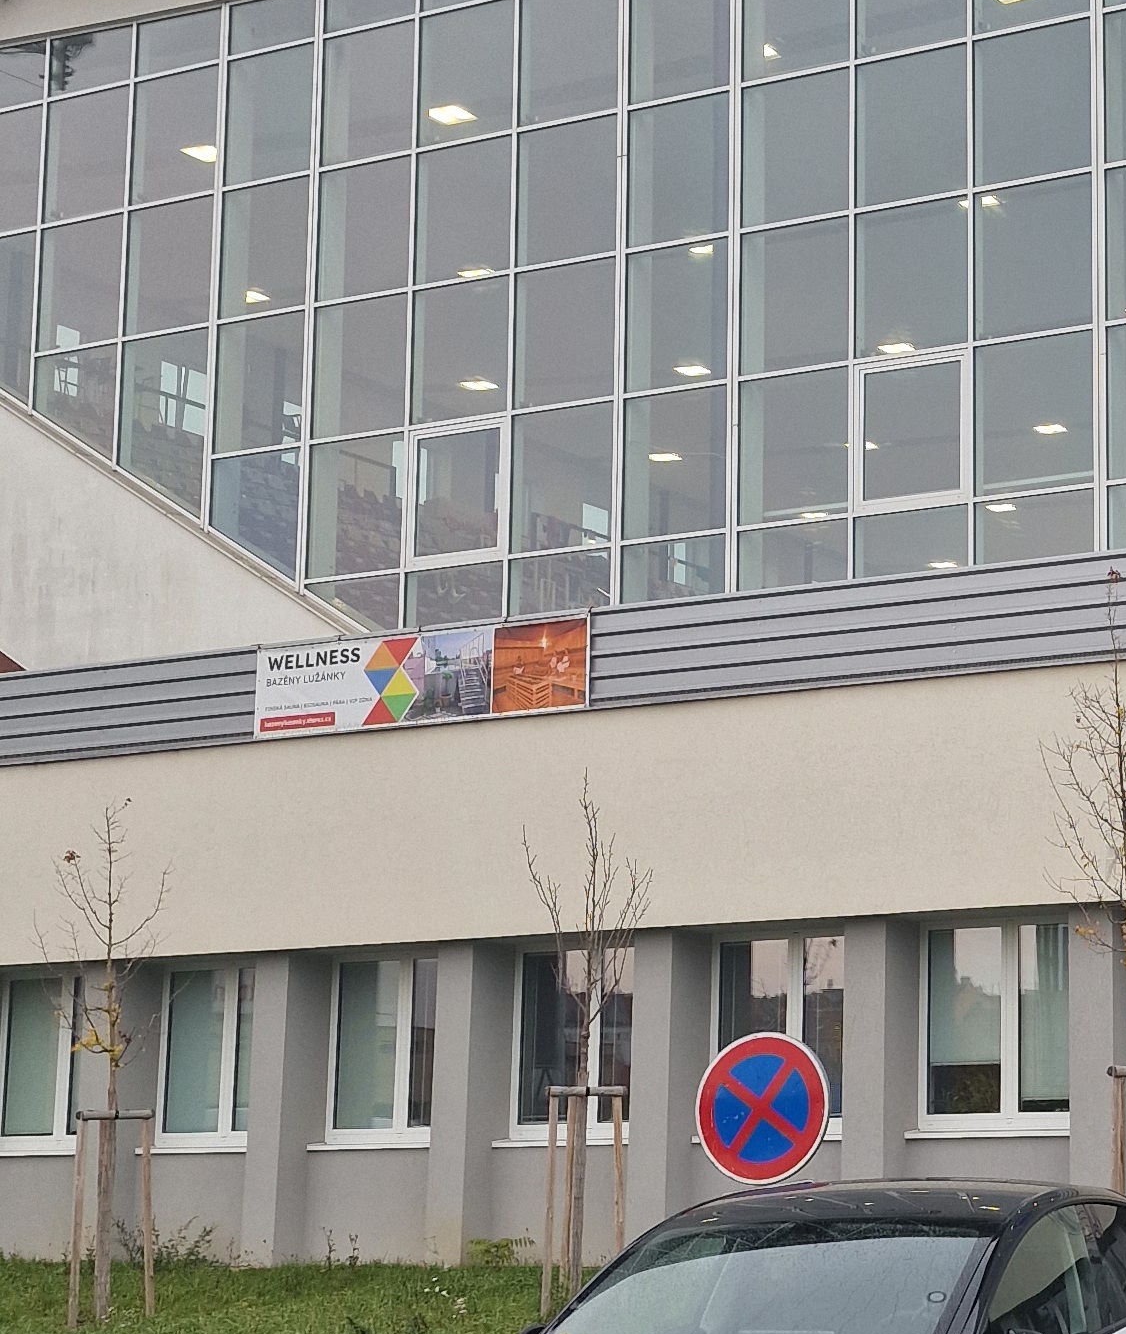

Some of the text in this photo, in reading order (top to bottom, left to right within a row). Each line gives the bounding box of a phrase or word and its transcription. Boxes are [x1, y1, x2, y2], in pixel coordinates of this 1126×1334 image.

[268, 647, 361, 671] WELLNESS
[266, 671, 346, 687] BAZÉNY LUŽÁNKY
